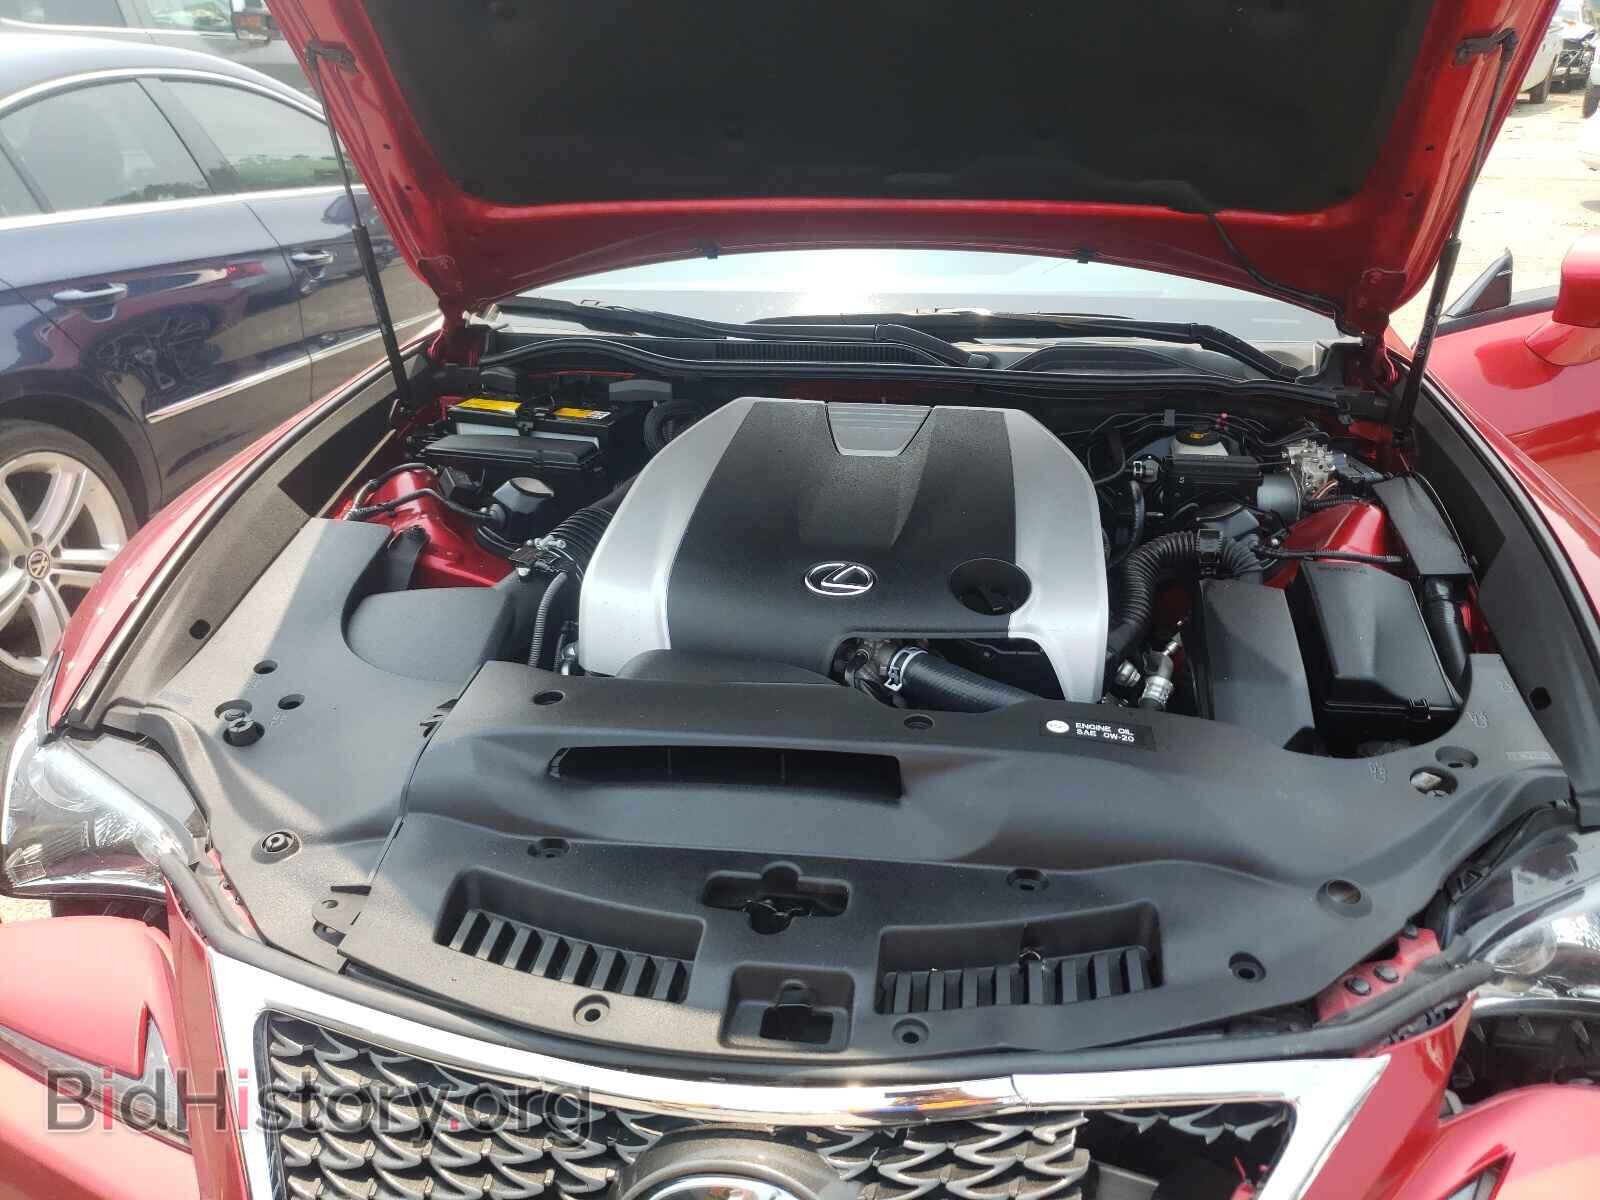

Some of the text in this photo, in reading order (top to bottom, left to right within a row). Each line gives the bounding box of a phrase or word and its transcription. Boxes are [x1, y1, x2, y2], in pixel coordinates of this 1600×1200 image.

[1075, 722, 1135, 736] ENGINE OIL
[1076, 728, 1097, 737] SAE
